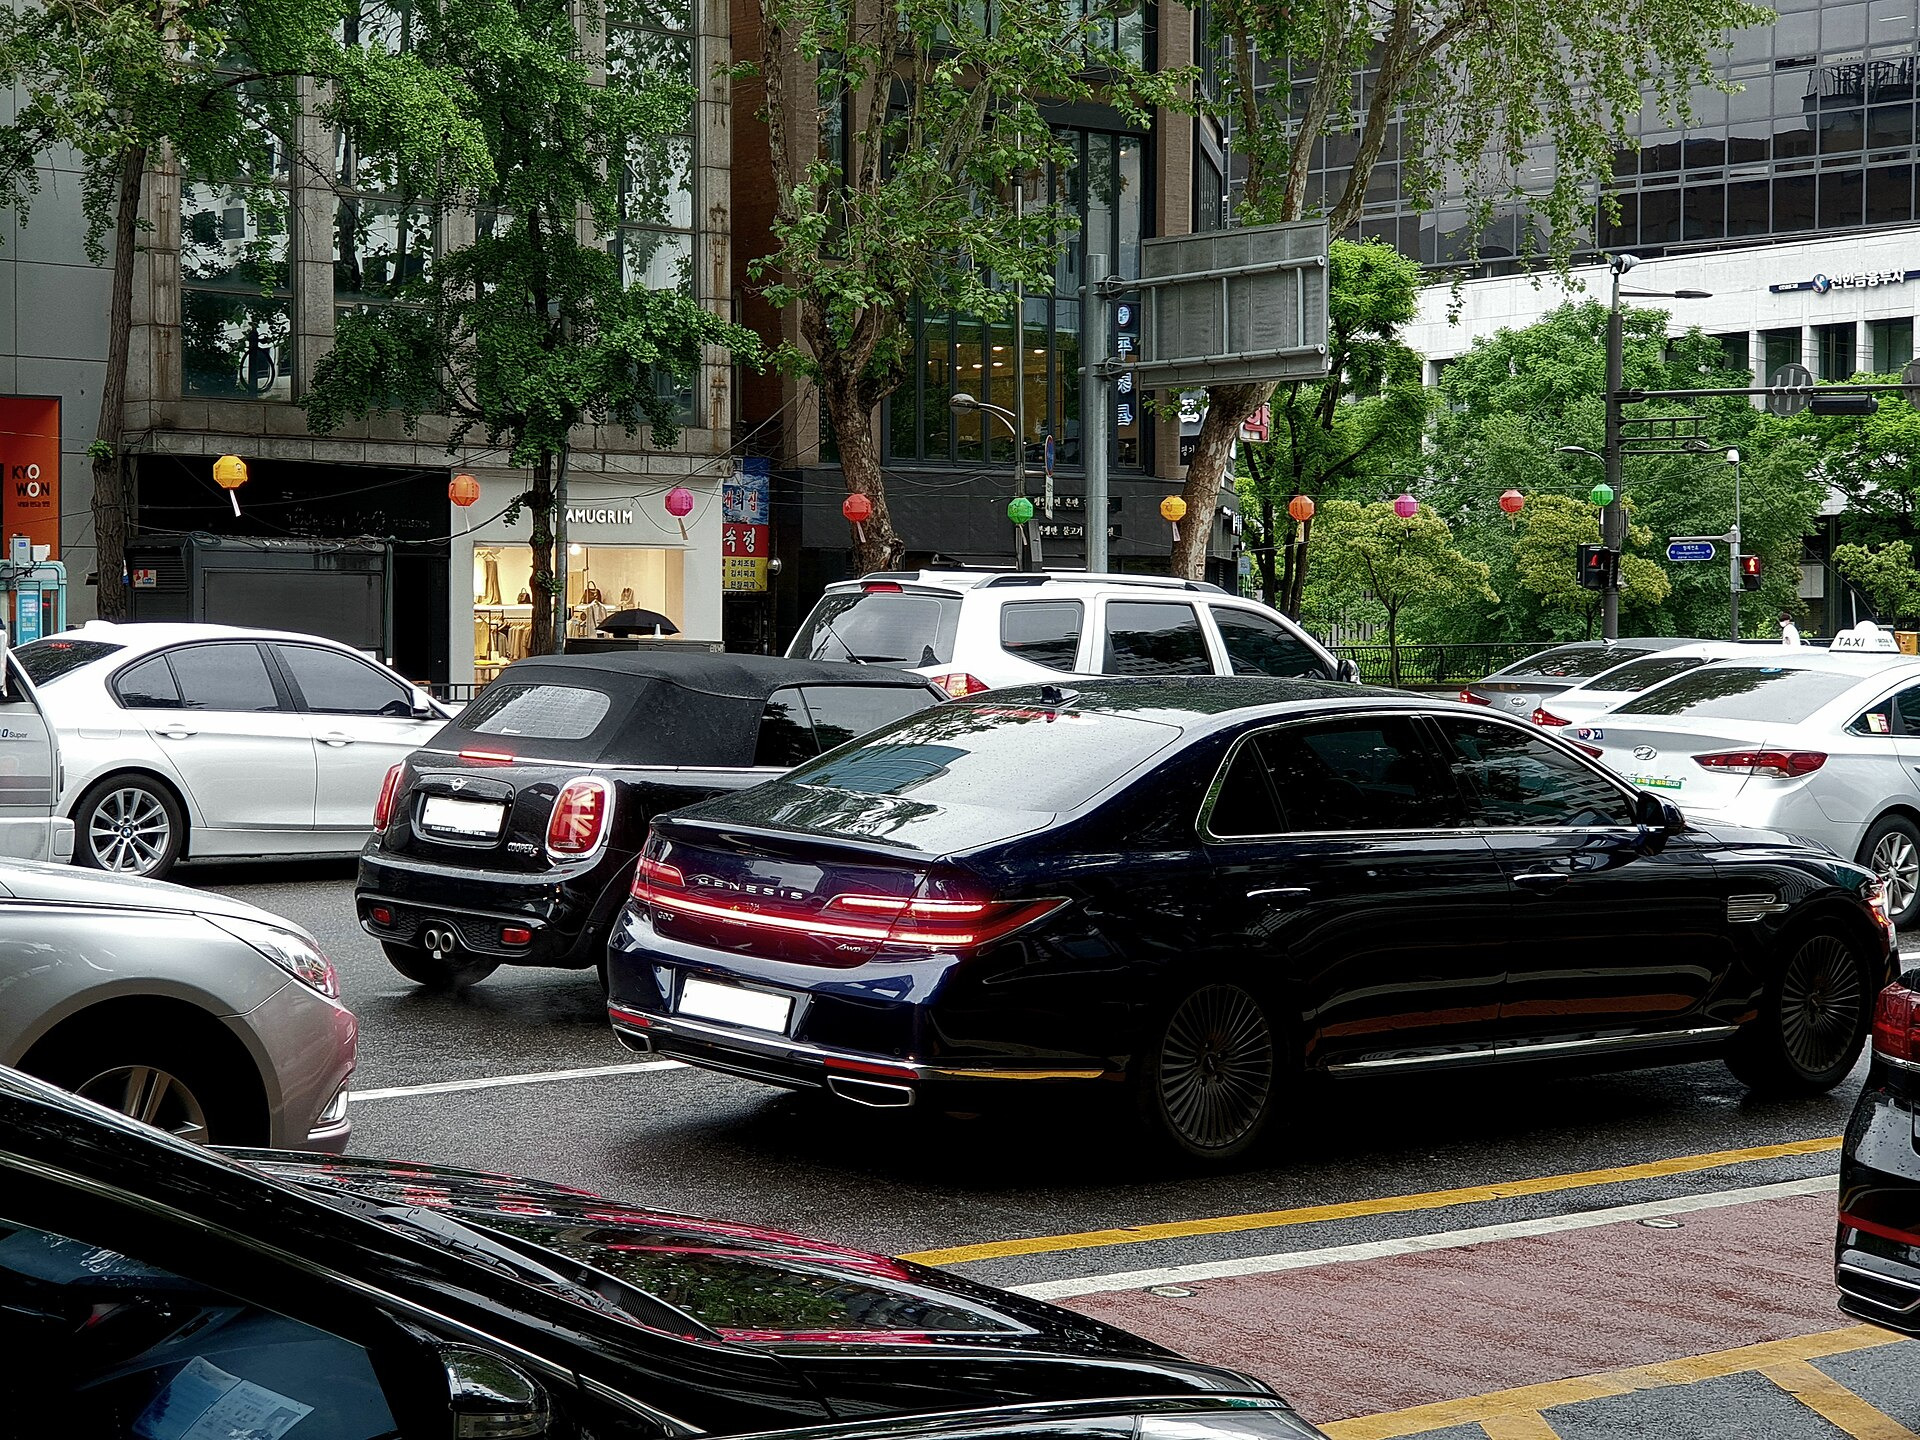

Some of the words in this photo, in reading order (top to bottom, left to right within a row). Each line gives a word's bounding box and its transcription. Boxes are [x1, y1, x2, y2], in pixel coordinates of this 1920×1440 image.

[1830, 268, 1905, 290] 신한금융투자
[12, 464, 40, 479] KYO
[16, 481, 50, 497] WON
[1838, 637, 1866, 648] TAXI
[507, 842, 534, 854] COOPER
[530, 847, 539, 857] S
[698, 876, 803, 900] GENESIS
[835, 942, 862, 953] AWD
